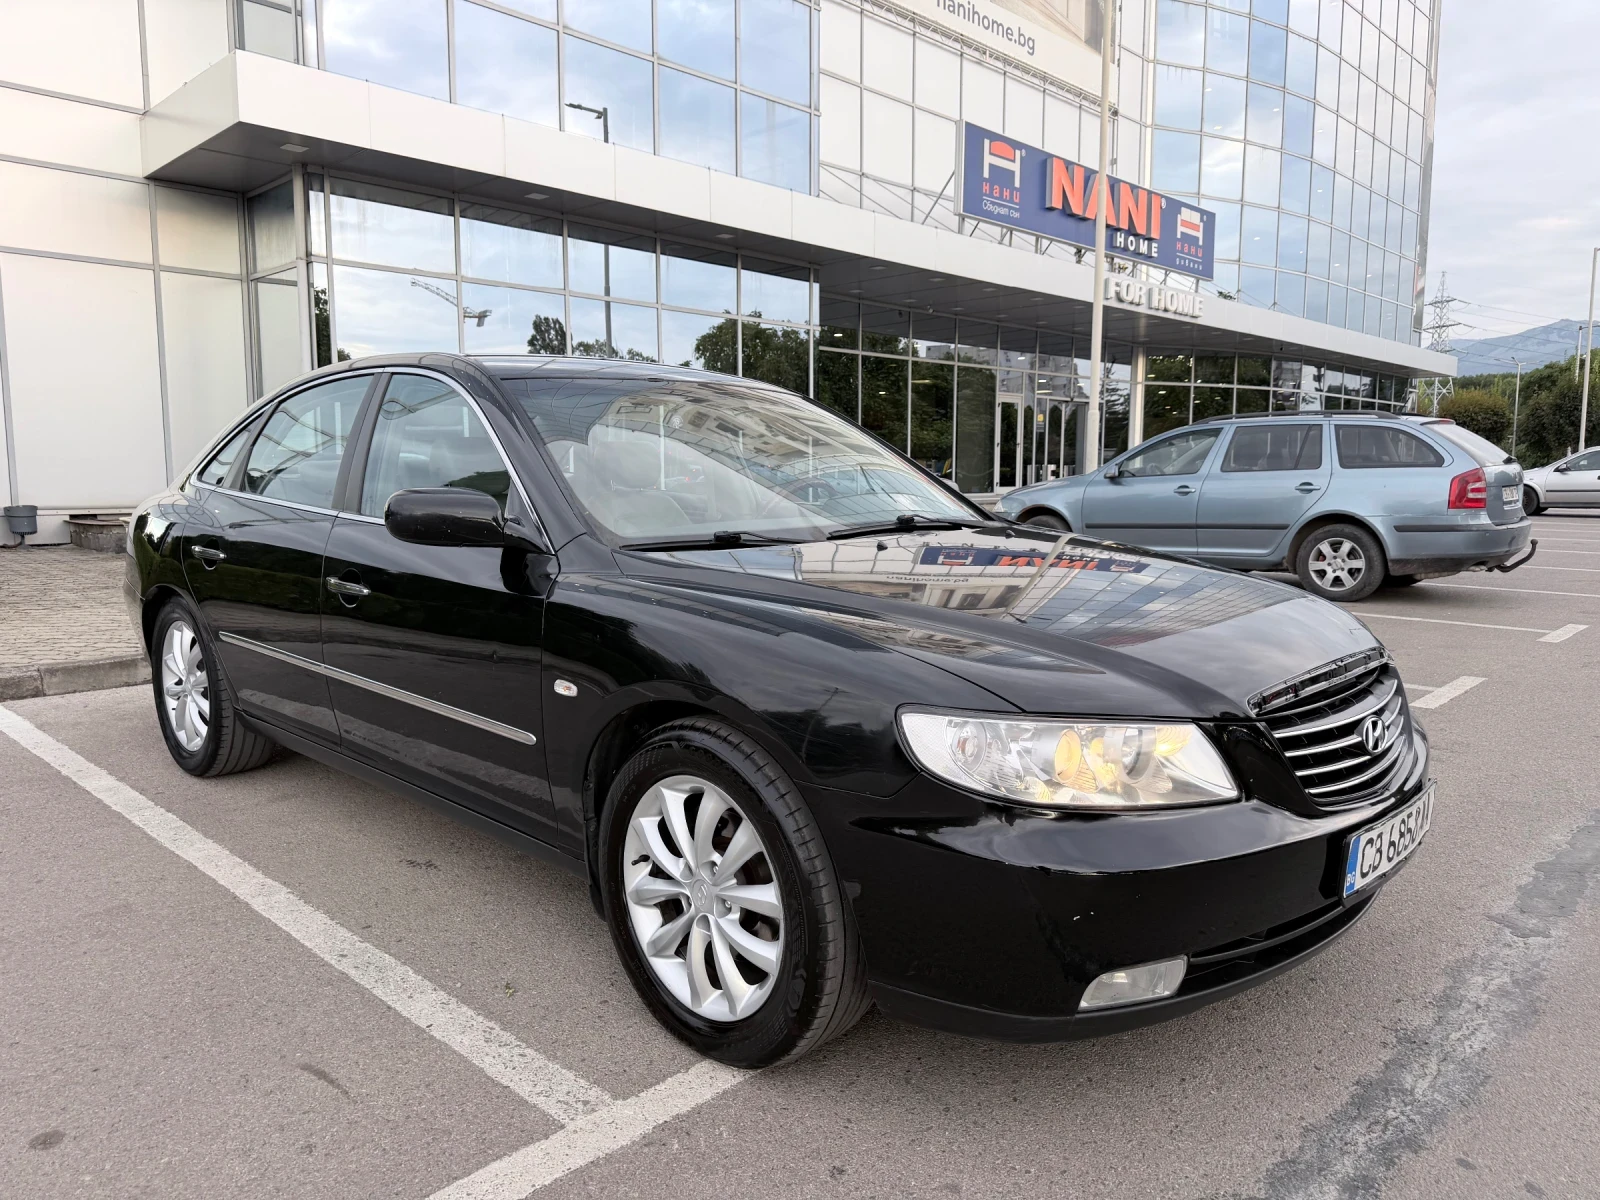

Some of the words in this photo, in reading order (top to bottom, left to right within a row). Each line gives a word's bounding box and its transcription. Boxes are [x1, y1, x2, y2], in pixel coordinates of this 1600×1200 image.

[1115, 231, 1158, 258] HOME
[1105, 277, 1147, 306] FOR
[1149, 287, 1204, 318] HOME
